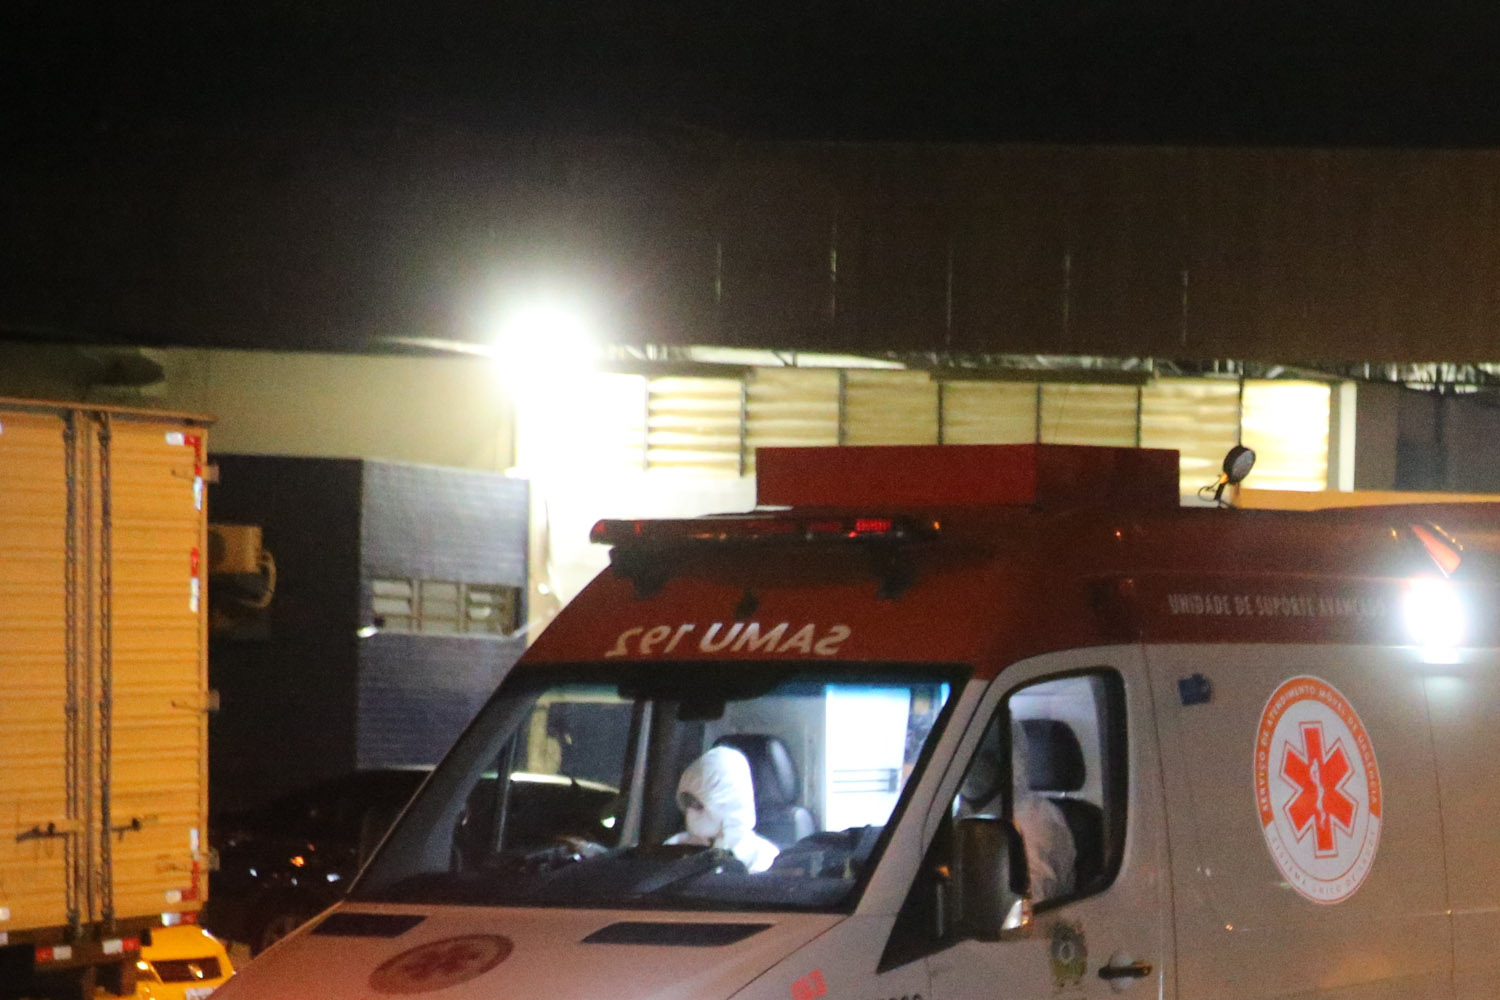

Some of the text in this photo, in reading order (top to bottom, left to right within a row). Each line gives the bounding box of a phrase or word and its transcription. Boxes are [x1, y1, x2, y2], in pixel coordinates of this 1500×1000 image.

[1168, 593, 1232, 615] UNIDADE
[1234, 594, 1254, 616] DE
[1255, 595, 1317, 617] SUPORTE
